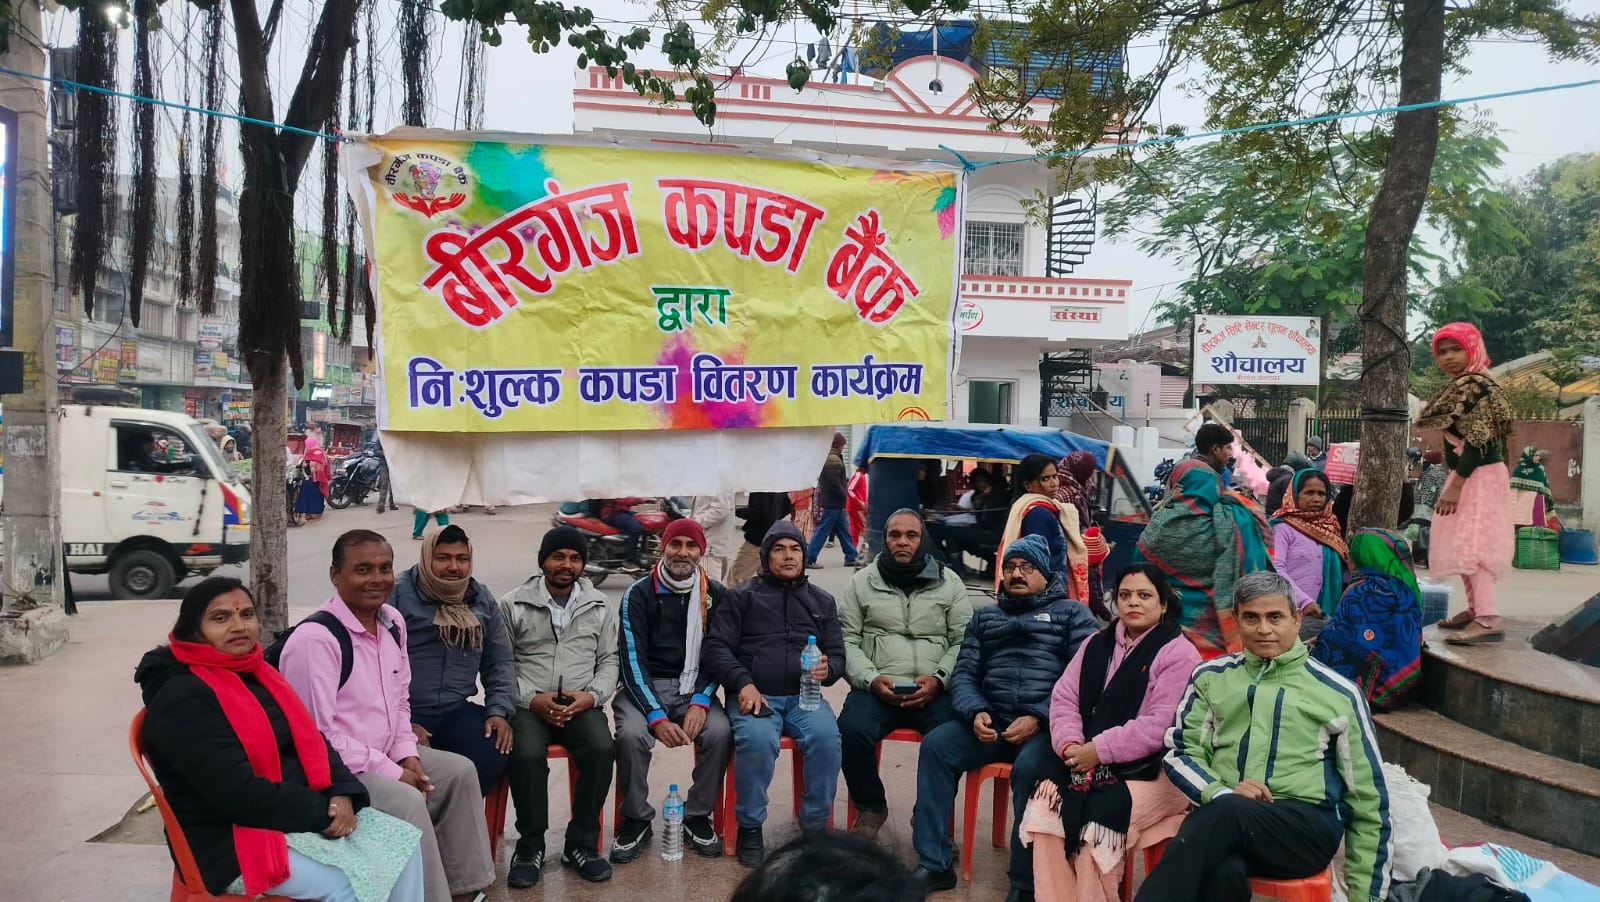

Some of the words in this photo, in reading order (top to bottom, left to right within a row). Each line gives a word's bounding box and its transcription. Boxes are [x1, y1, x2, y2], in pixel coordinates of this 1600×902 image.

[658, 179, 825, 273] कपडा
[827, 210, 919, 323] बैंक
[652, 287, 731, 331] द्वारा
[579, 367, 677, 403] कपडा
[692, 354, 798, 401] वितरण
[811, 354, 923, 400] कार्यक्रम
[1211, 351, 1306, 373] शौचालय
